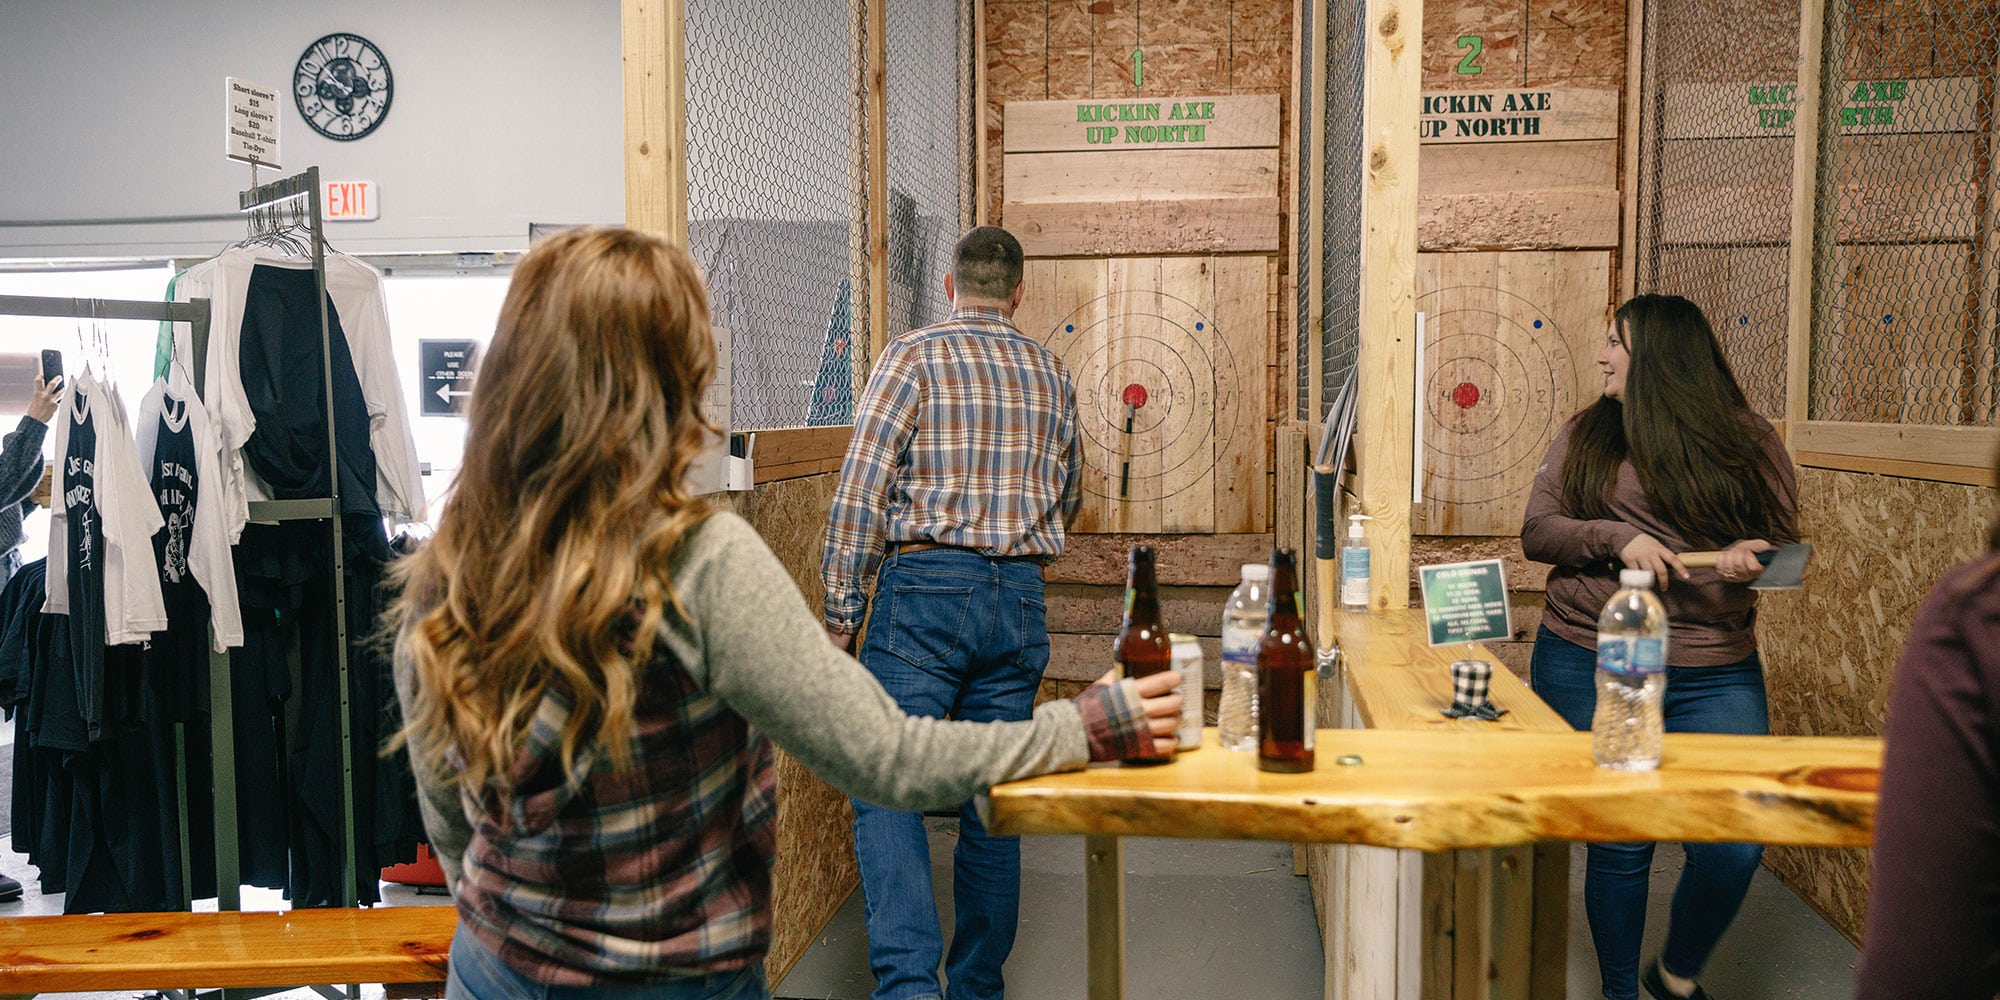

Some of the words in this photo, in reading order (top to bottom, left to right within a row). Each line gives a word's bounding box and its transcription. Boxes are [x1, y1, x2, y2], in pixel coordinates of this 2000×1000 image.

[313, 41, 332, 66] 11
[332, 37, 350, 58] 12
[356, 43, 365, 63] 1
[1457, 35, 1483, 75] 2
[299, 59, 321, 81] 10
[362, 58, 382, 75] 2
[1131, 50, 1144, 87] 1
[233, 83, 250, 95] Short
[251, 89, 269, 100] sleeve
[297, 83, 317, 98] 9
[368, 78, 388, 92] 3
[249, 98, 260, 108] $15
[304, 99, 323, 118] 8
[365, 94, 385, 114] 4
[1077, 103, 1161, 122] KICKIN
[1168, 102, 1216, 121] AXE
[1420, 94, 1494, 115] ICKIN
[1502, 92, 1551, 112] AXE
[234, 105, 249, 118] Long
[250, 110, 268, 121] sleeve
[268, 114, 274, 122] T
[323, 110, 339, 131] 7
[356, 111, 373, 130] 5
[248, 120, 260, 129] $20
[341, 114, 354, 135] 6
[1086, 126, 1119, 144] UP
[1124, 124, 1206, 143] NORTH
[1455, 117, 1541, 137] NORTH
[231, 126, 256, 139] Baseball
[256, 133, 277, 145] T-shirt
[242, 141, 266, 154] Tie-Dye
[328, 183, 369, 217] EXIT
